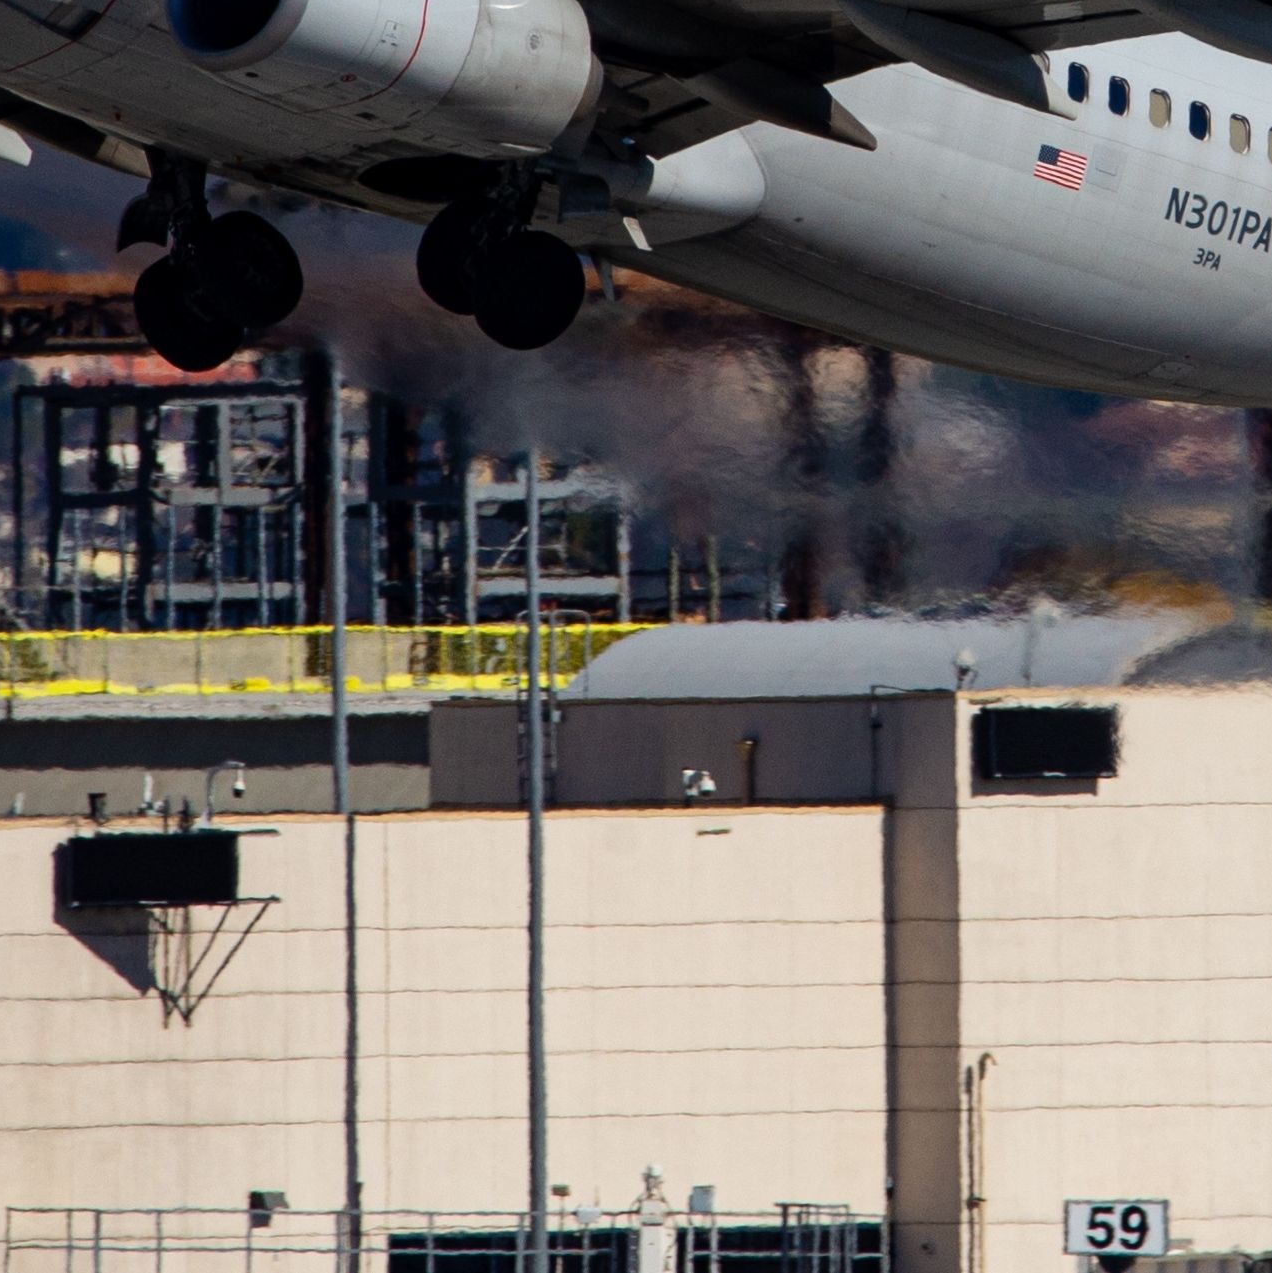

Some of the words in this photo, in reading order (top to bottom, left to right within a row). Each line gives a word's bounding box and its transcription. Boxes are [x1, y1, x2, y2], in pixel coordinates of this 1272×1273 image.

[1164, 187, 1272, 253] N301PA
[1192, 247, 1222, 271] 3PA
[1087, 1205, 1149, 1251] 59
